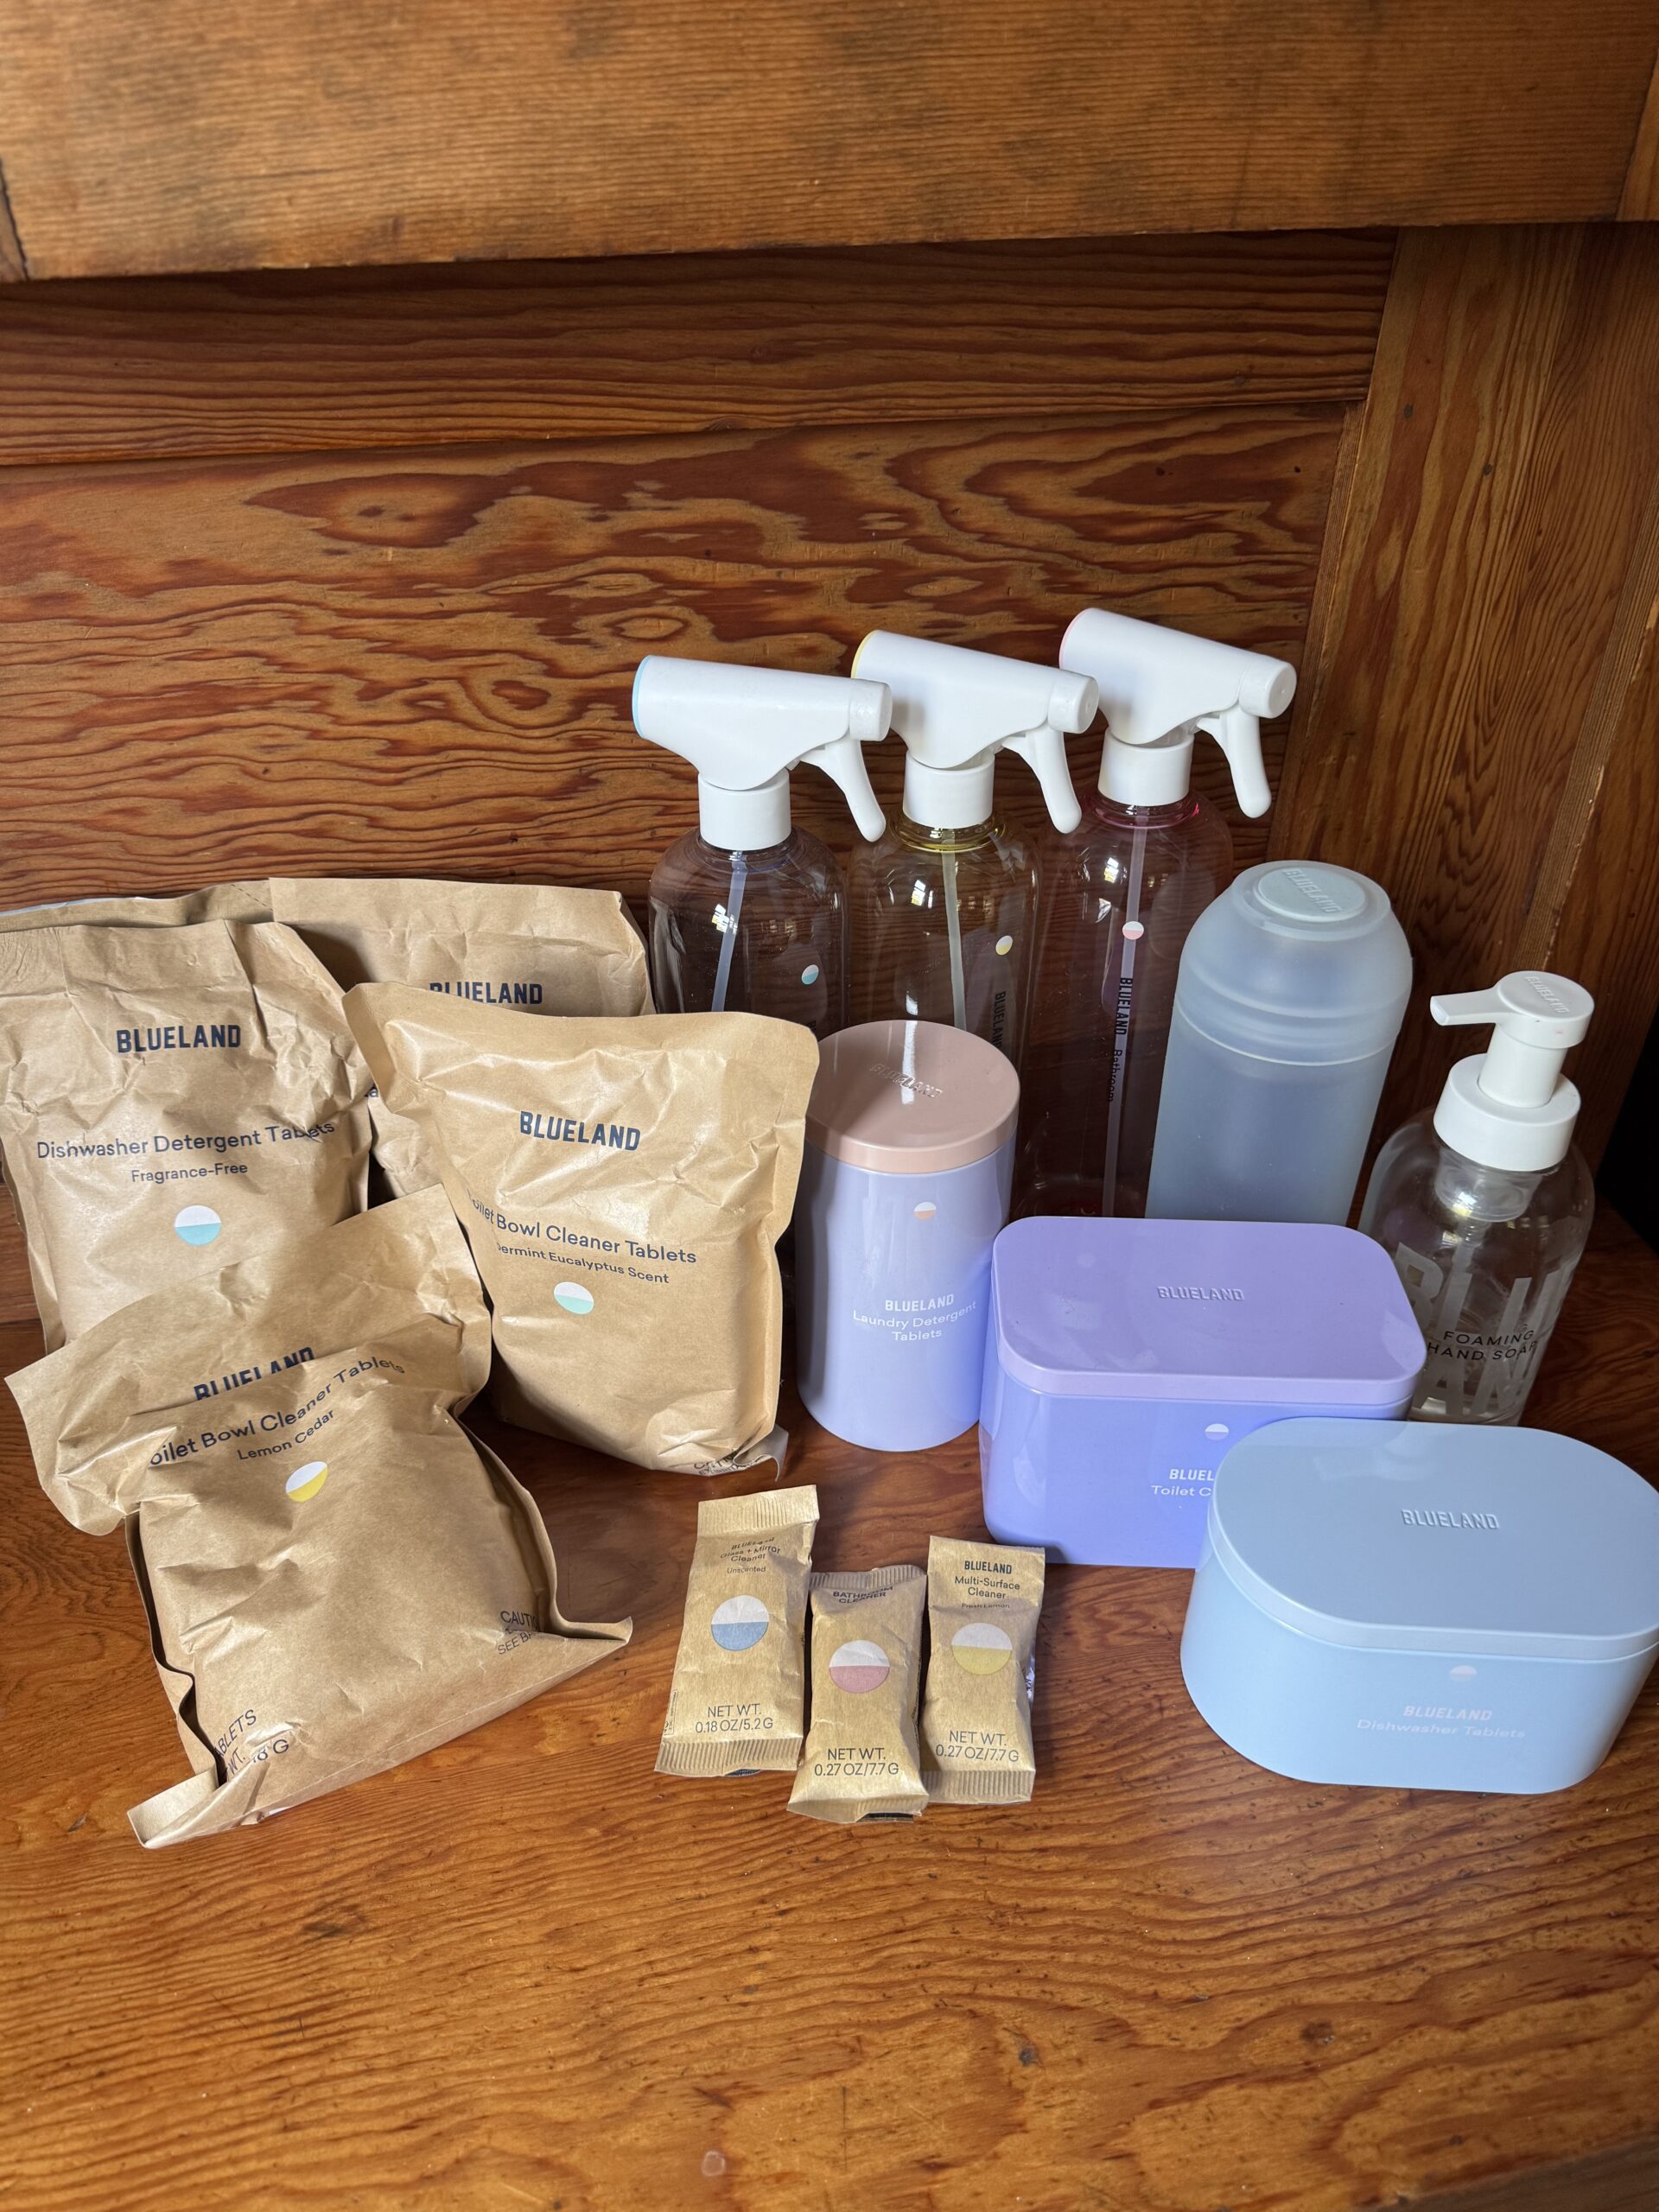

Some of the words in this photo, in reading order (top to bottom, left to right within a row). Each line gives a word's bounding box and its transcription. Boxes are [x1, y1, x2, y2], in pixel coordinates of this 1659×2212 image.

[1115, 977, 1134, 1036] BLUELAND
[116, 1025, 242, 1053] BLUELAND
[1106, 1048, 1123, 1103] Bathroom
[520, 1111, 642, 1151] BLUELAND
[36, 1138, 149, 1159] Dishwasher
[154, 1129, 261, 1154] Detergent
[130, 1163, 248, 1185] Fragrance-Free
[472, 1198, 494, 1224] oilet
[496, 1213, 540, 1238] Bowl
[546, 1224, 620, 1254] Cleaner
[625, 1240, 697, 1263] Tablets
[549, 1251, 625, 1274] Eucalyptus
[627, 1266, 670, 1284] Scent
[1157, 1285, 1244, 1301] BLUELAND
[885, 1294, 954, 1312] BLUELAND
[853, 1309, 909, 1331] Laundry
[912, 1300, 976, 1328] Detergent
[892, 1329, 943, 1341] Tablets
[1443, 1329, 1535, 1347] FOAMING
[1427, 1342, 1484, 1361] HAND
[1491, 1340, 1538, 1361] SOAP
[150, 1438, 198, 1465] oilet
[200, 1420, 256, 1448] Bowl
[260, 1383, 333, 1432] Cleaner
[334, 1357, 405, 1383] Tablets
[237, 1441, 292, 1460] Lemon
[295, 1409, 335, 1444] Cedar
[1168, 1468, 1215, 1481] BLUEL
[1151, 1484, 1195, 1497] Toilet
[1401, 1509, 1500, 1529] BLUELAND
[730, 1553, 766, 1562] Cleaner
[753, 1545, 781, 1554] Mirror
[727, 1566, 766, 1574] Unscented
[964, 1560, 1013, 1574] BLUELAND
[954, 1575, 1020, 1590] Multi-Surface
[968, 1586, 1007, 1599] Cleaner
[498, 1636, 520, 1655] SEE
[708, 1705, 734, 1718] NET
[736, 1703, 762, 1716] WT.
[1402, 1705, 1493, 1721] BLUELAND
[214, 1708, 257, 1757] ABLETS
[695, 1720, 718, 1733] 0.18
[720, 1717, 761, 1732] OZ/5.2
[763, 1717, 773, 1729] G
[1357, 1719, 1458, 1735] Dishwasher
[1463, 1726, 1526, 1738] Tablets
[272, 1738, 289, 1754] G
[949, 1730, 977, 1744] NET
[980, 1732, 1007, 1746] WT.
[827, 1747, 856, 1761] NET
[858, 1747, 886, 1760] WT.
[936, 1744, 963, 1758] 0.27
[964, 1746, 1007, 1762] OZ/7.7
[1008, 1750, 1020, 1763] G
[814, 1763, 842, 1777] 0.27
[843, 1762, 886, 1777] OZ/7.7
[887, 1762, 899, 1776] G
